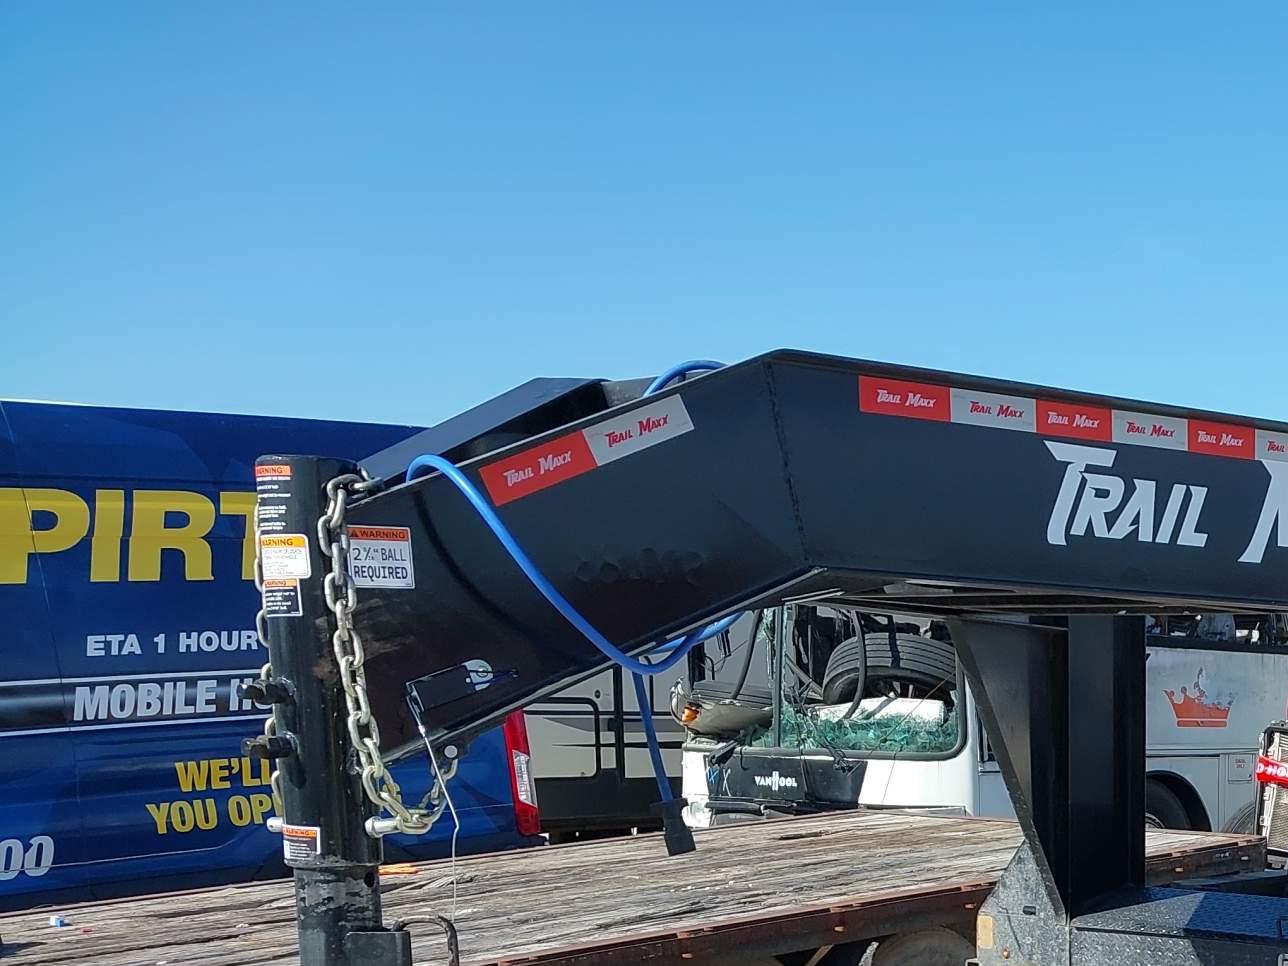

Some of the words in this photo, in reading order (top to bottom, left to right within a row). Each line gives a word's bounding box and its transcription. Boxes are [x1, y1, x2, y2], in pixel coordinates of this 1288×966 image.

[1043, 440, 1208, 547] TRAIL
[360, 530, 406, 539] WARNING
[381, 547, 407, 562] BALL
[353, 565, 408, 582] REQUIRED
[86, 634, 143, 657] ETA
[154, 633, 165, 654] 1
[179, 630, 259, 653] HOUR
[73, 679, 217, 721] MOBILE
[145, 798, 219, 835] YOU
